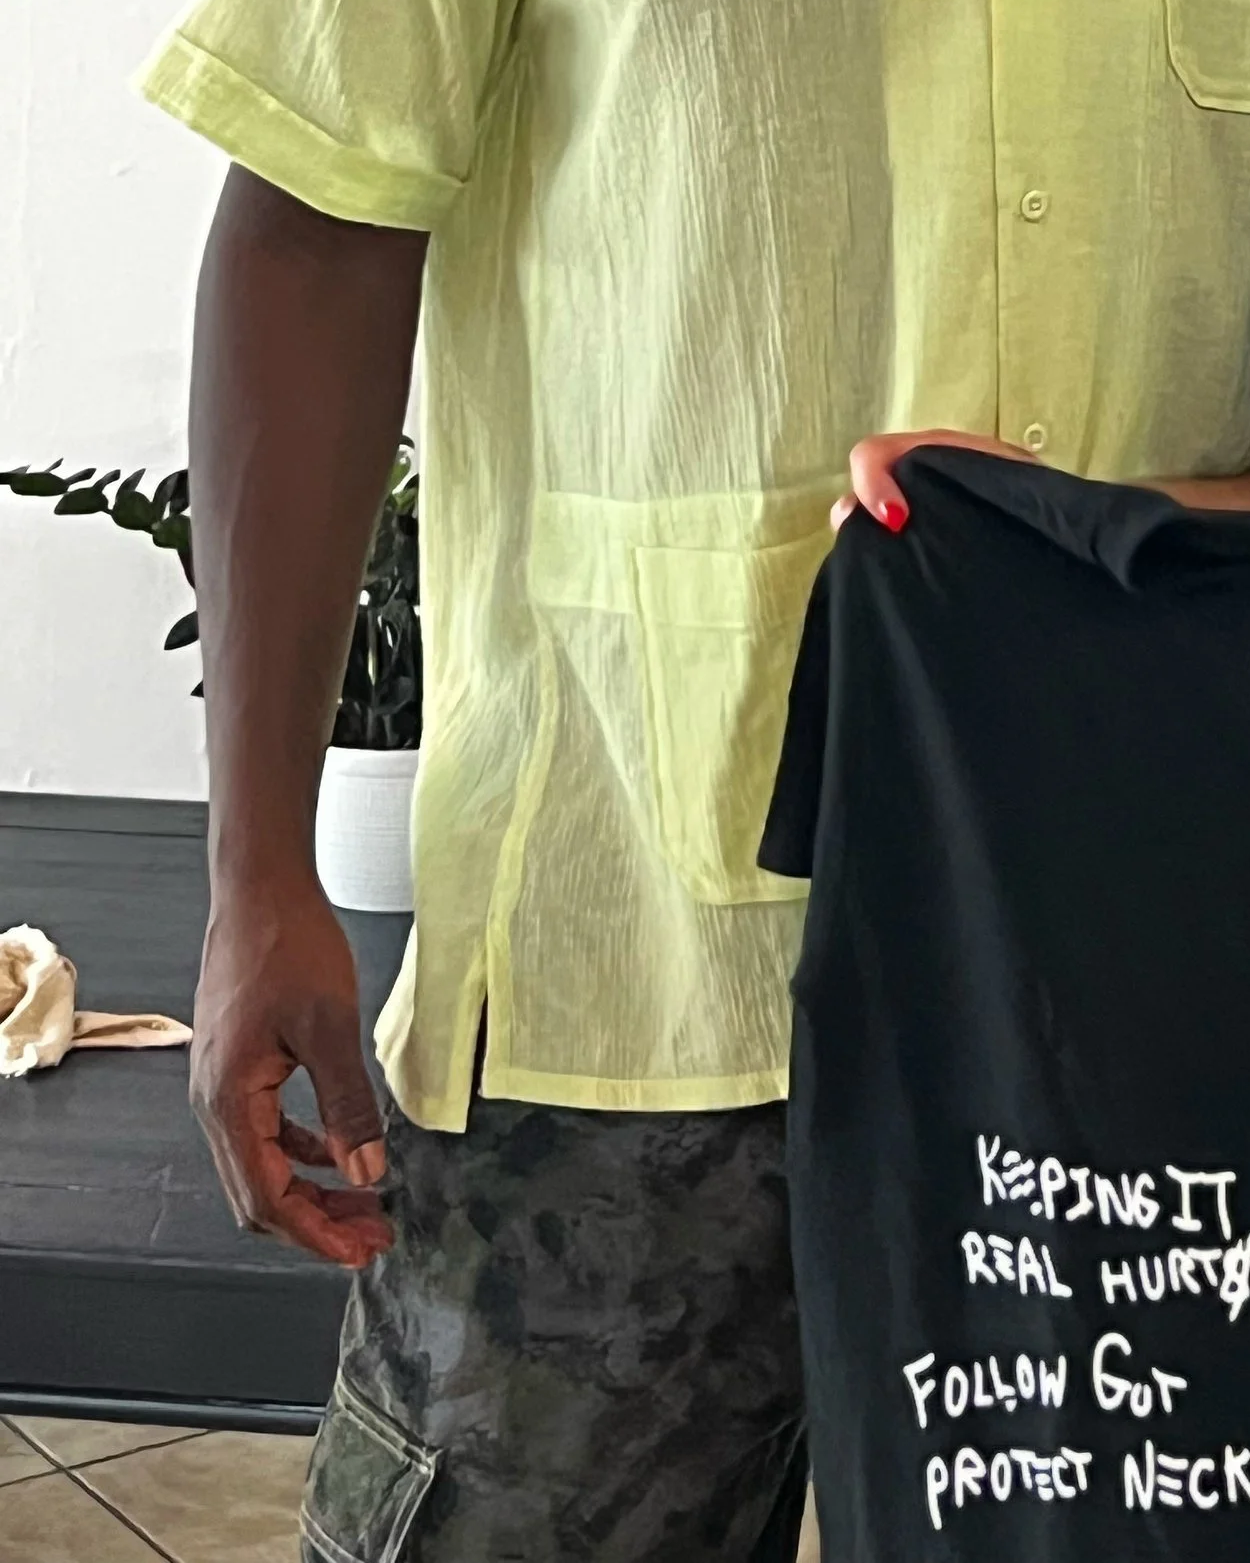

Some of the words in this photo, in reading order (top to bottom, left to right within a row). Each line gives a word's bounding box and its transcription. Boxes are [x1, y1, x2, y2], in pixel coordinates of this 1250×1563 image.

[1165, 1164, 1237, 1241] IT
[960, 1231, 1073, 1298] REAL
[902, 1352, 1067, 1429] FOLLOW
[1092, 1332, 1188, 1418] GUT
[926, 1446, 1093, 1531] PROTECT
